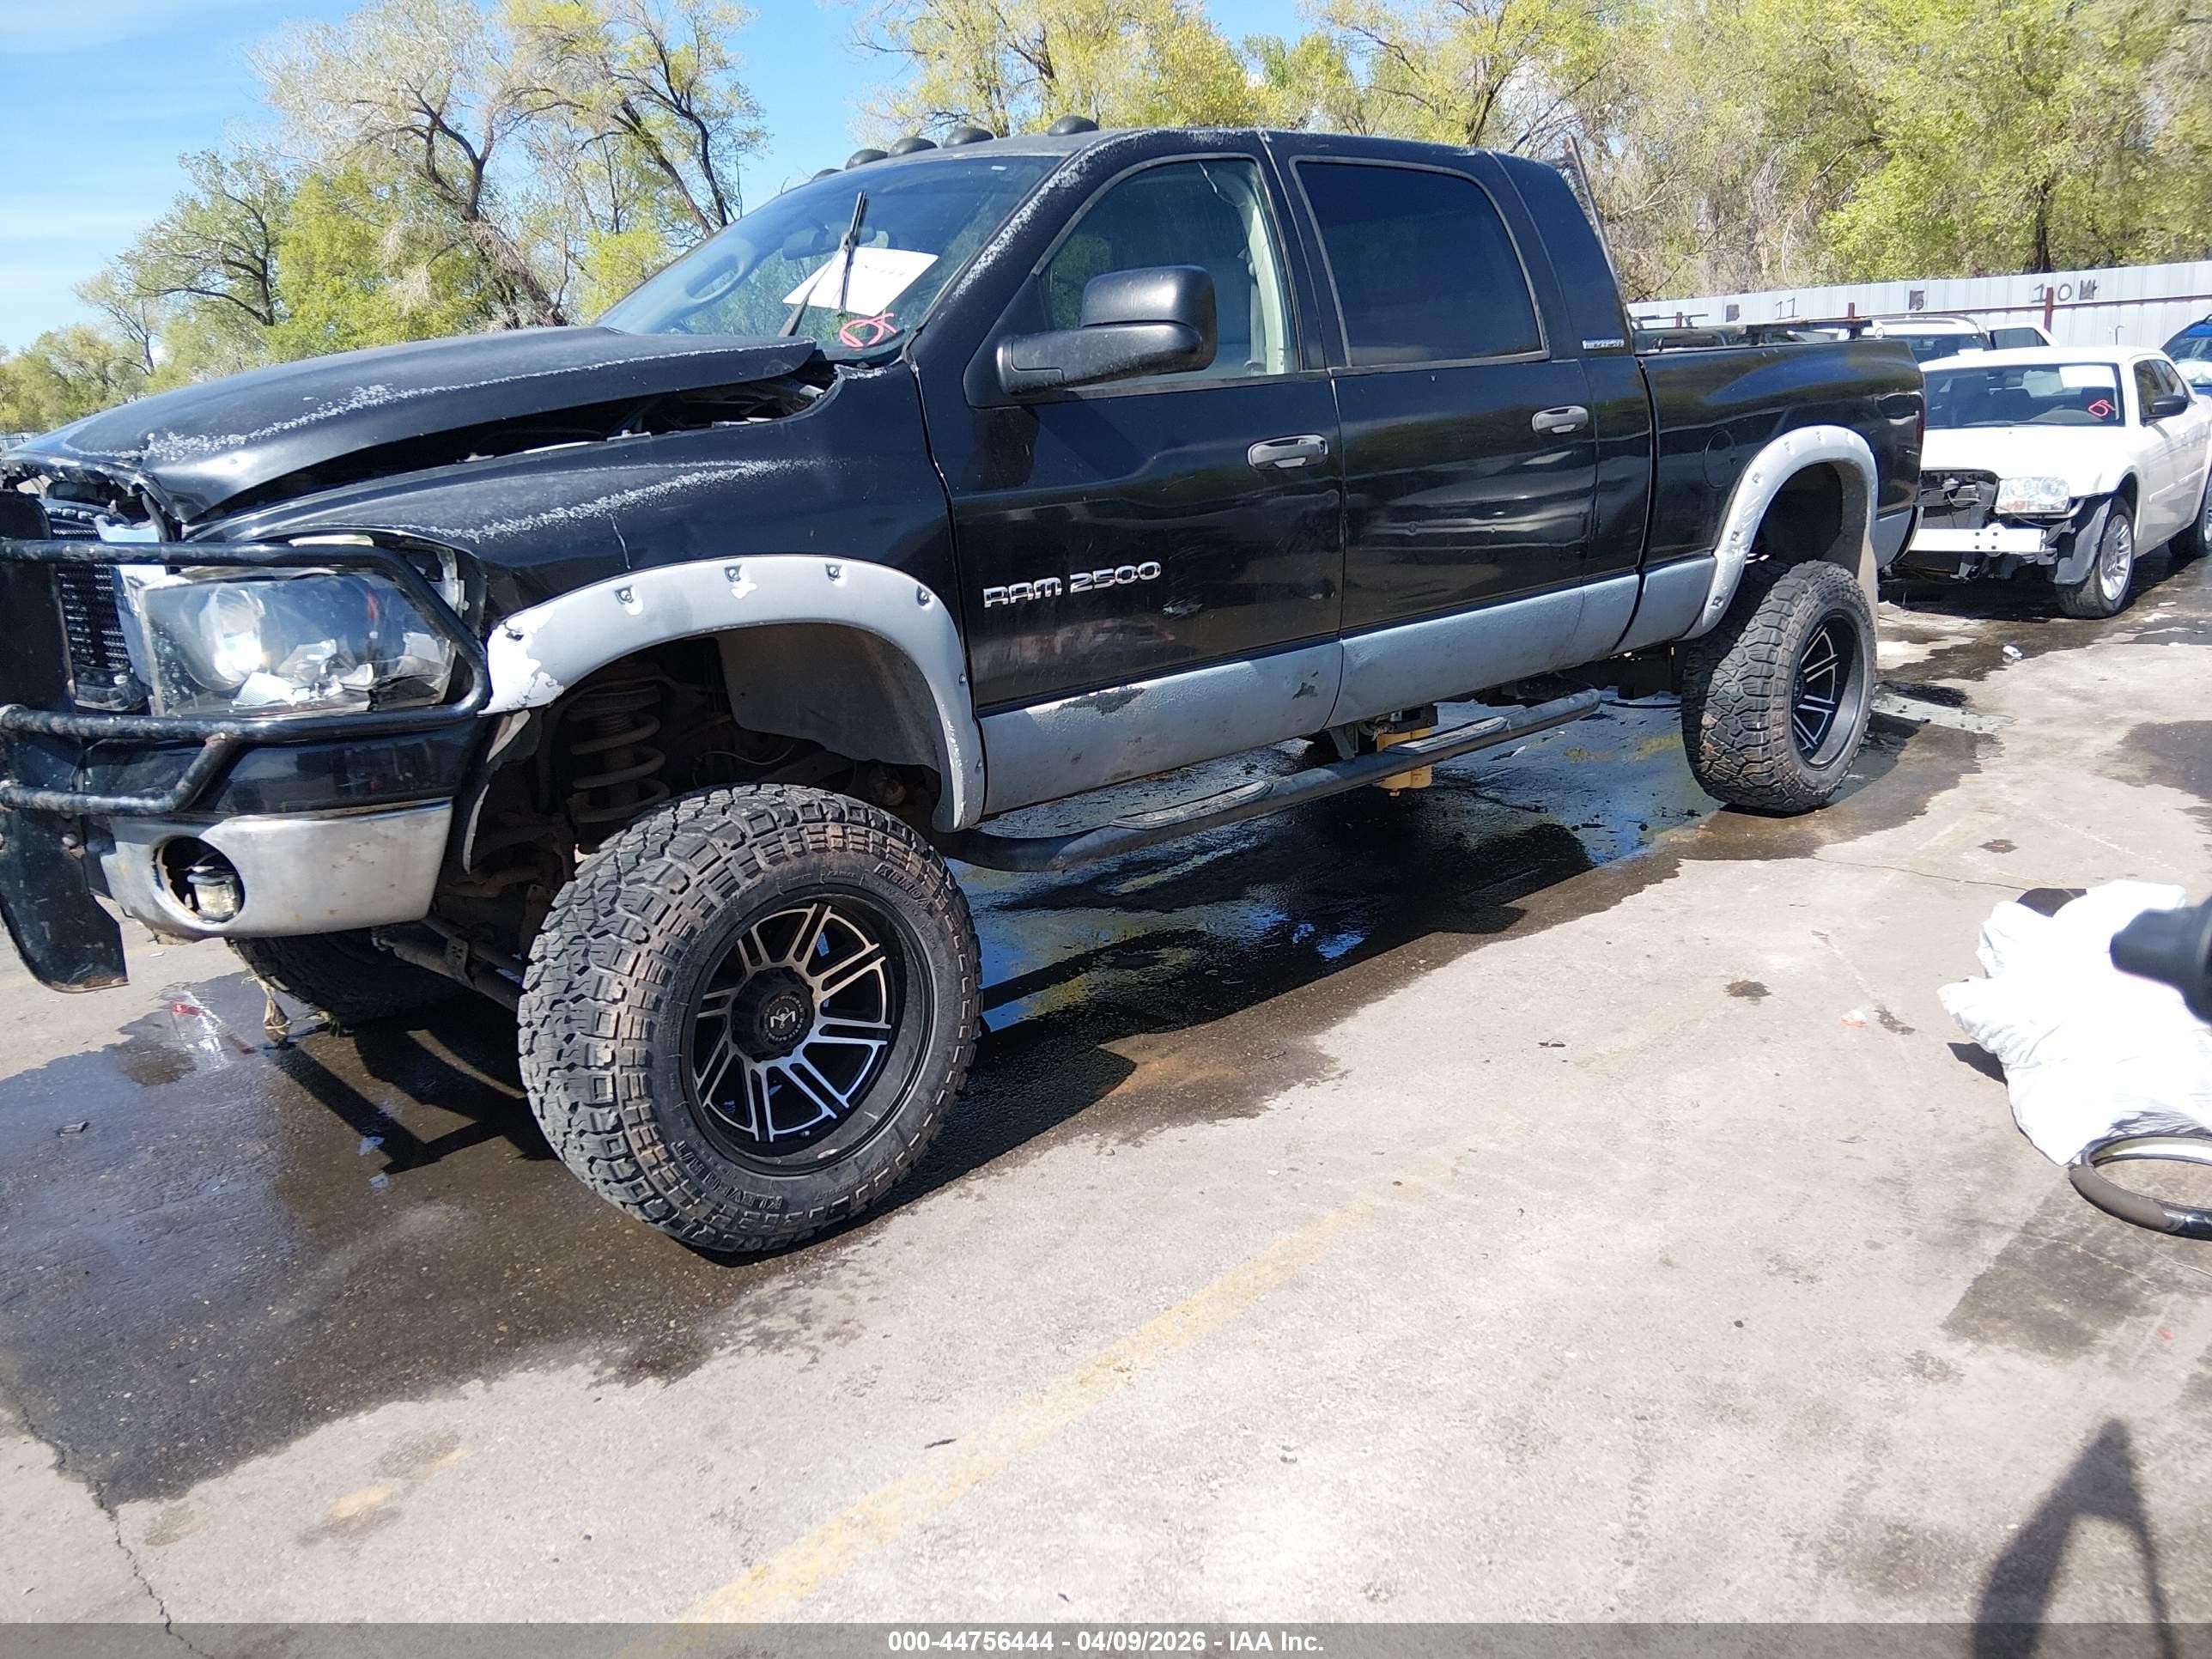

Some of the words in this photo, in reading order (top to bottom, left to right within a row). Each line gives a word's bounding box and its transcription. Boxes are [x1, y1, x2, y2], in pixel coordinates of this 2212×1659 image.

[983, 576, 1062, 608] RAM
[1069, 561, 1162, 593] 2500
[873, 862, 930, 910] KENDA
